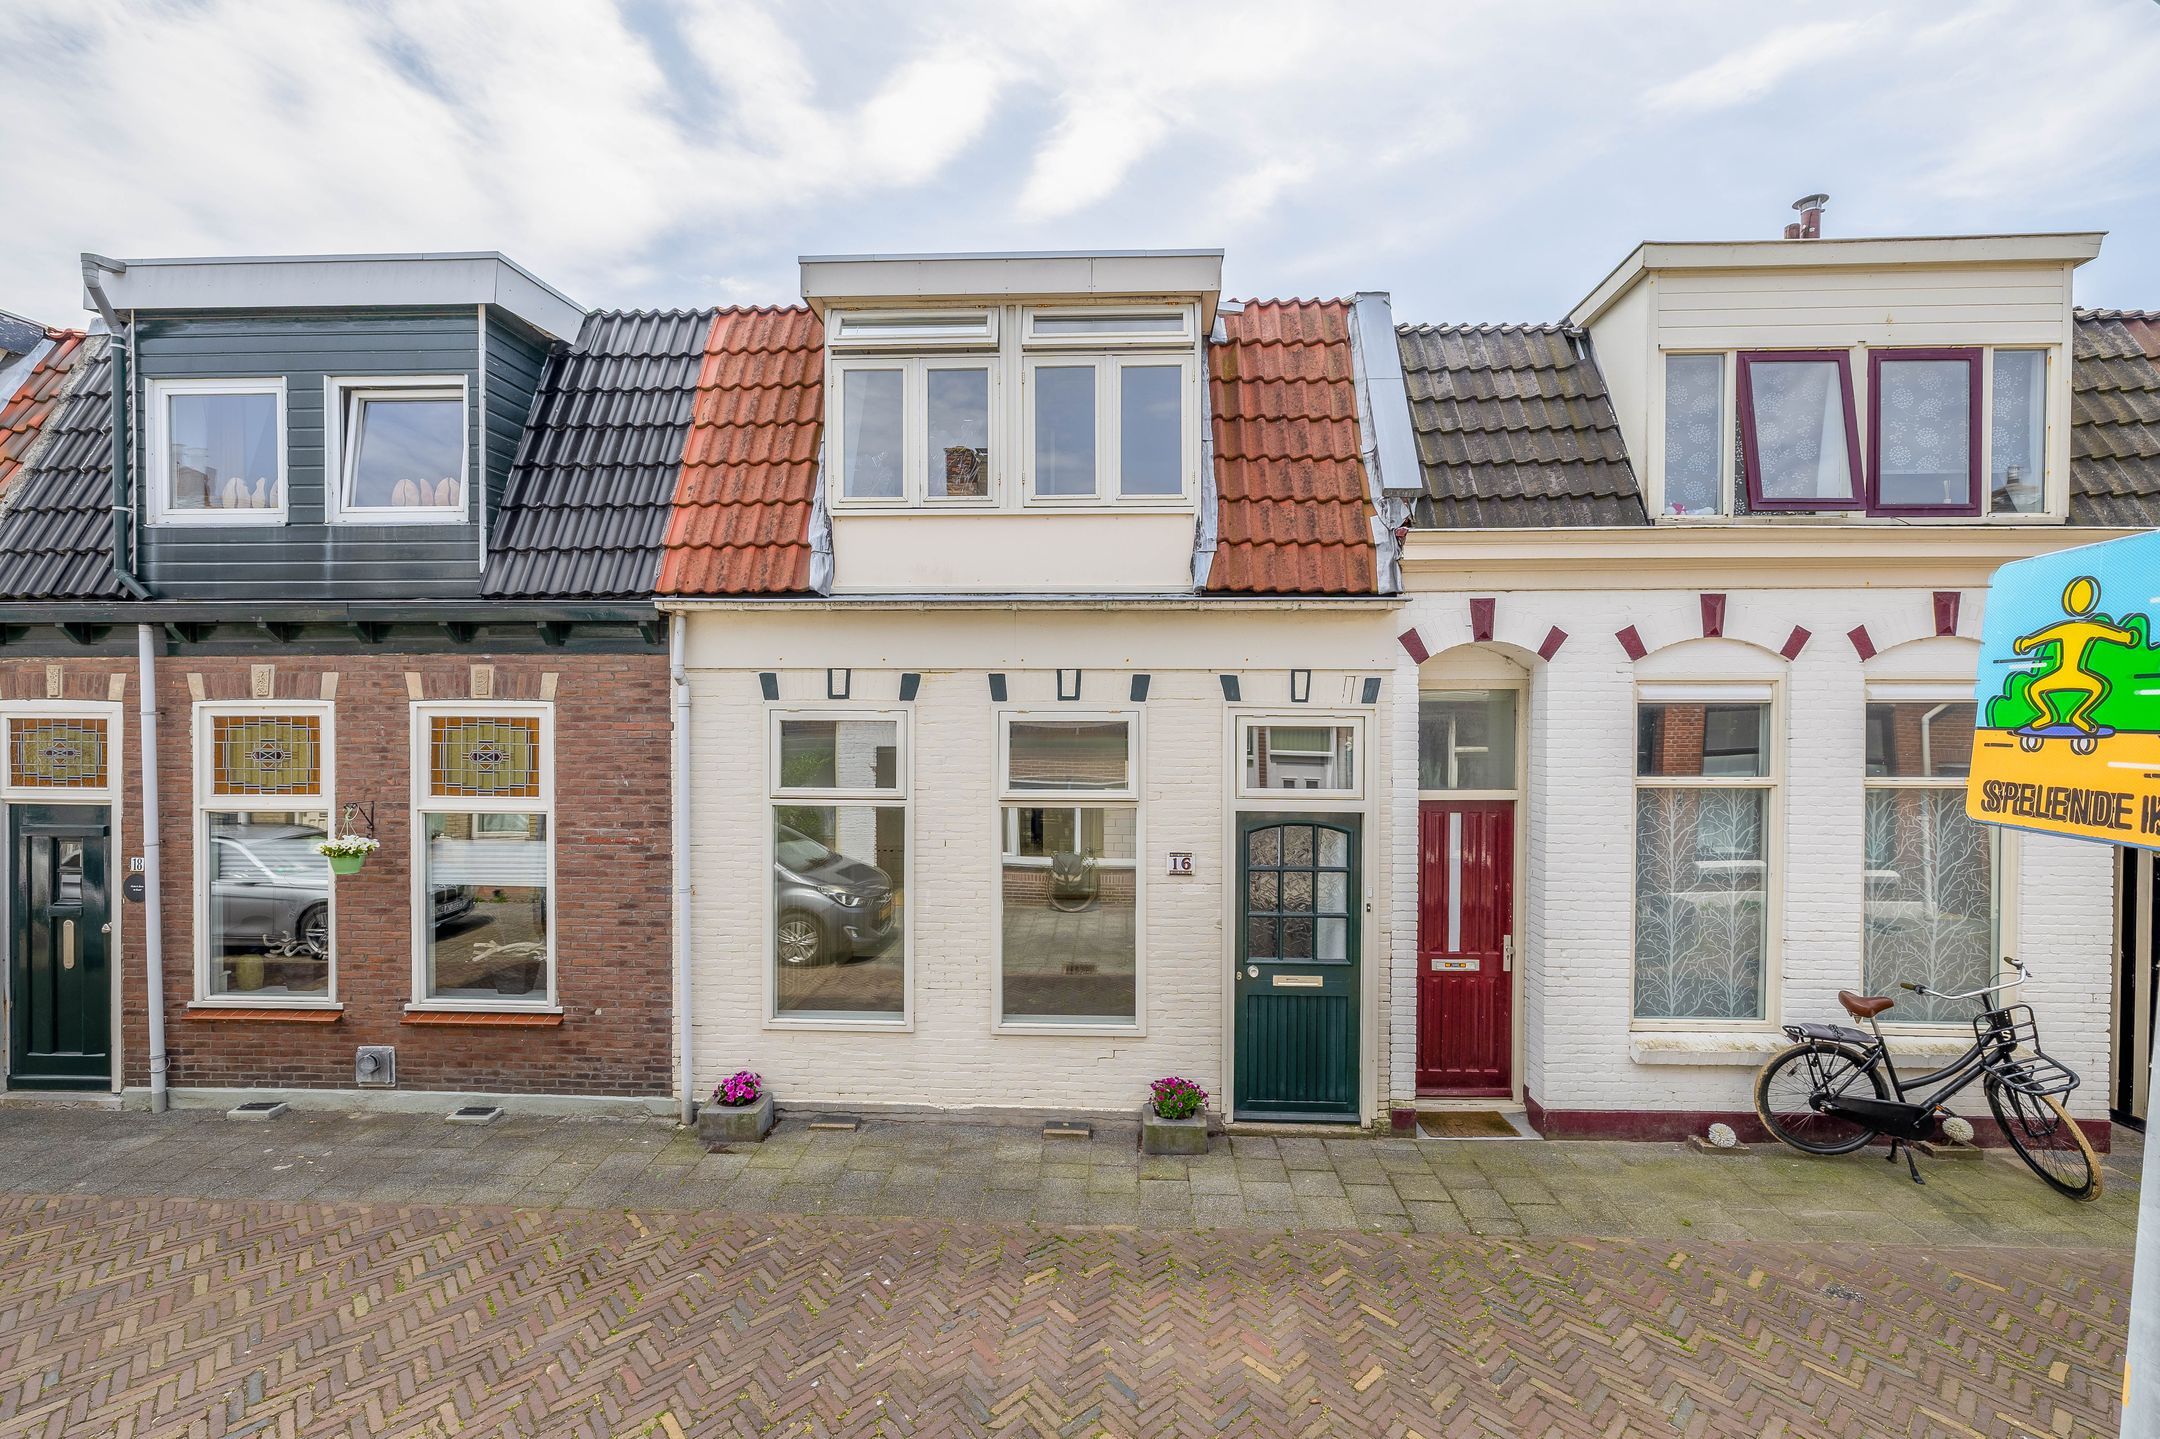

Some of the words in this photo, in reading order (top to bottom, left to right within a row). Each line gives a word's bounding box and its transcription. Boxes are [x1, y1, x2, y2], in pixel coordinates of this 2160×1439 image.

[1980, 779, 2134, 831] SPELENDE
[132, 858, 143, 871] 18
[1172, 857, 1192, 871] 16
